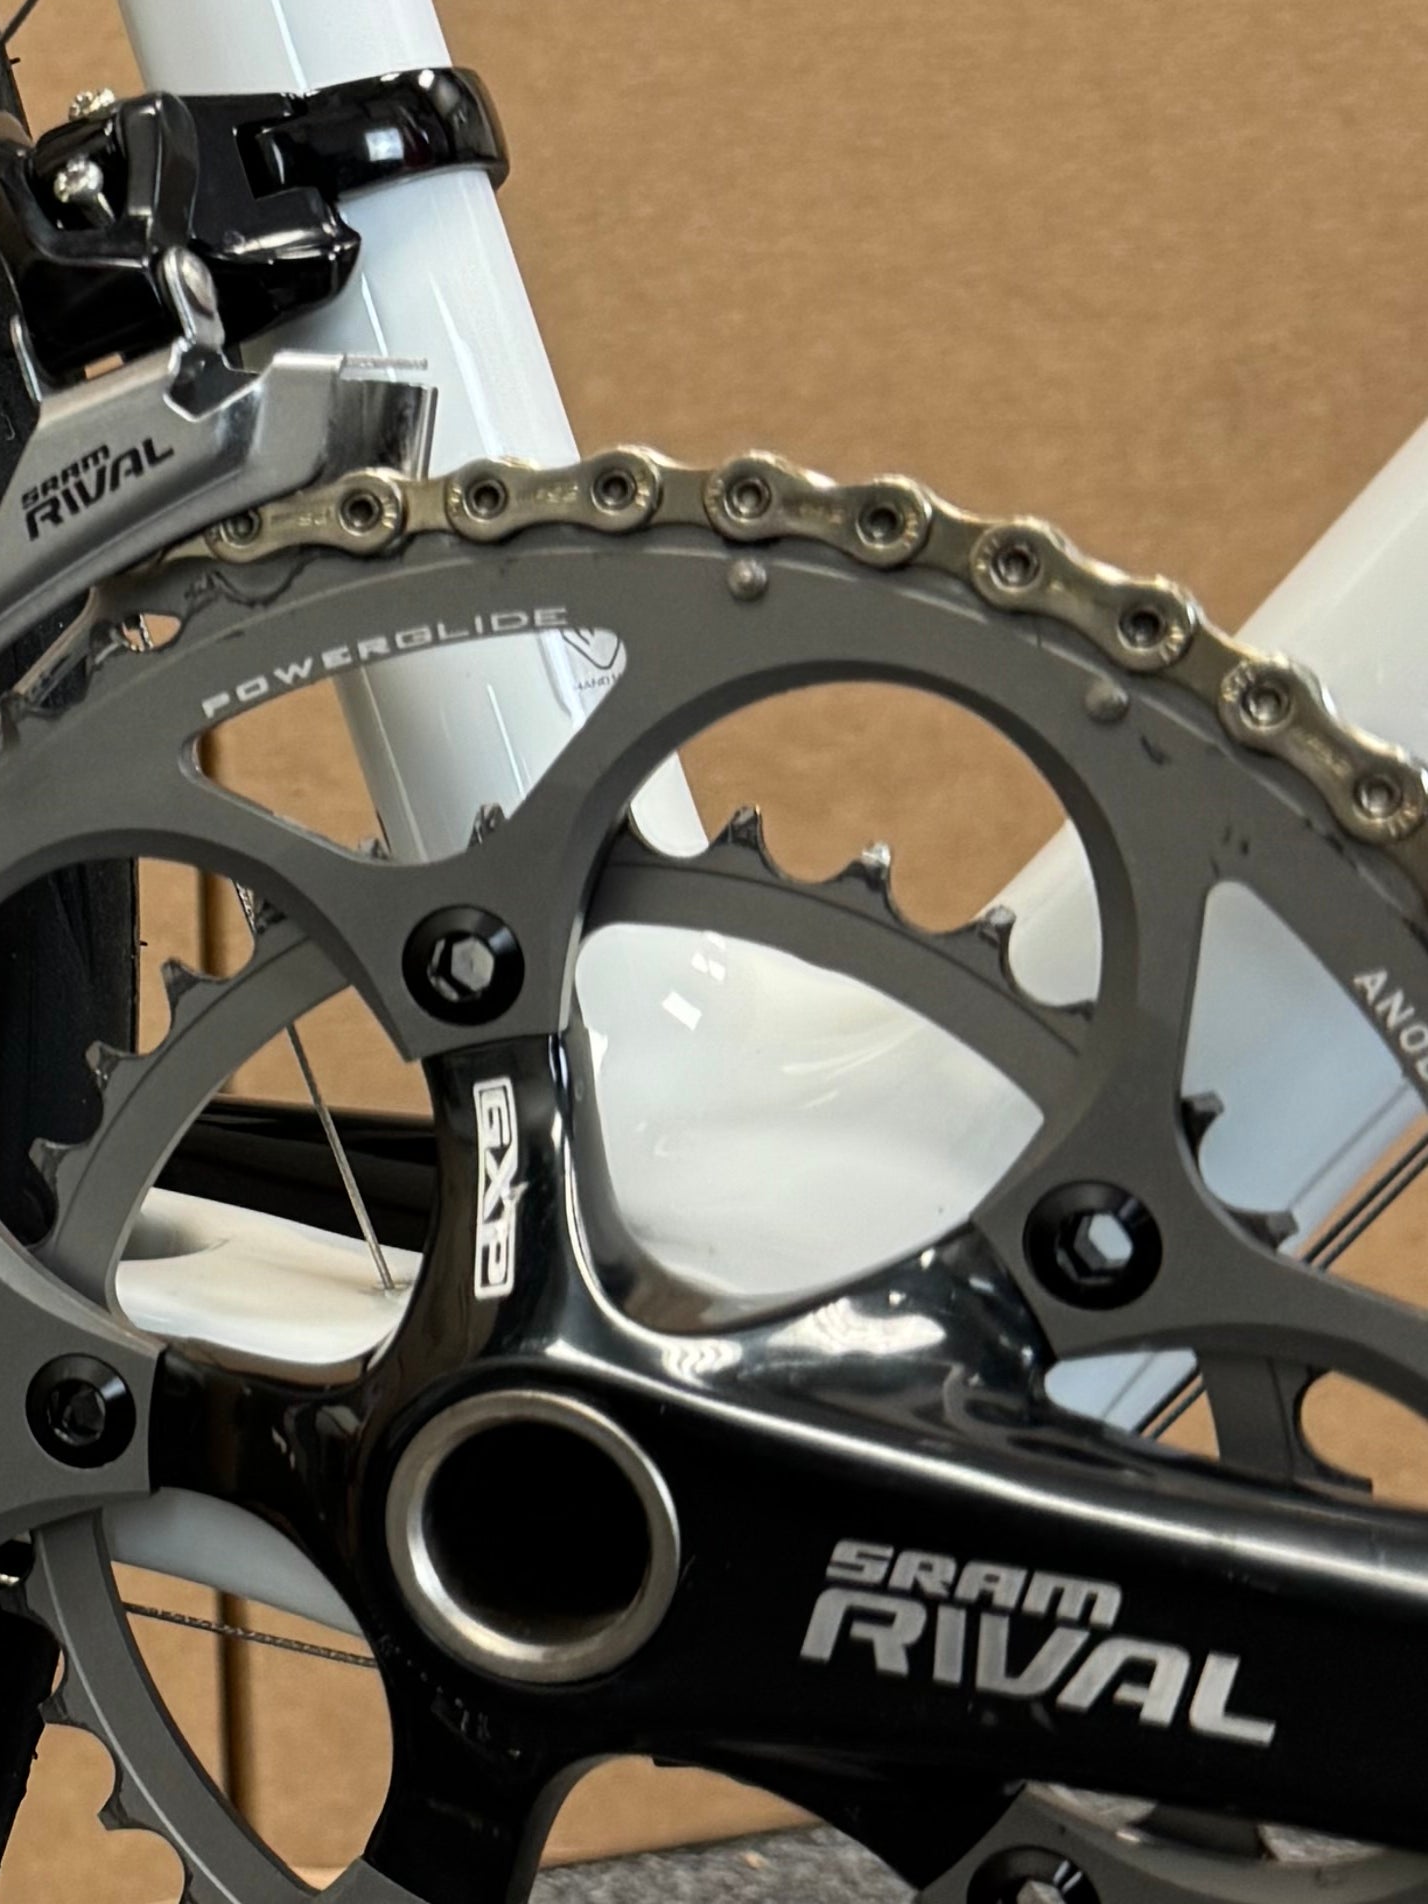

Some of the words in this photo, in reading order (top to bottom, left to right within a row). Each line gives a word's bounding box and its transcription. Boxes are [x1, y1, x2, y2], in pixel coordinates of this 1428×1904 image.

[21, 444, 111, 510] SRAM
[26, 436, 175, 541] RIVAL
[201, 606, 568, 719] POWERGLIDE
[474, 1078, 520, 1299] GXP
[825, 1539, 1123, 1631] SRAM
[800, 1587, 1276, 1748] RIVAL
